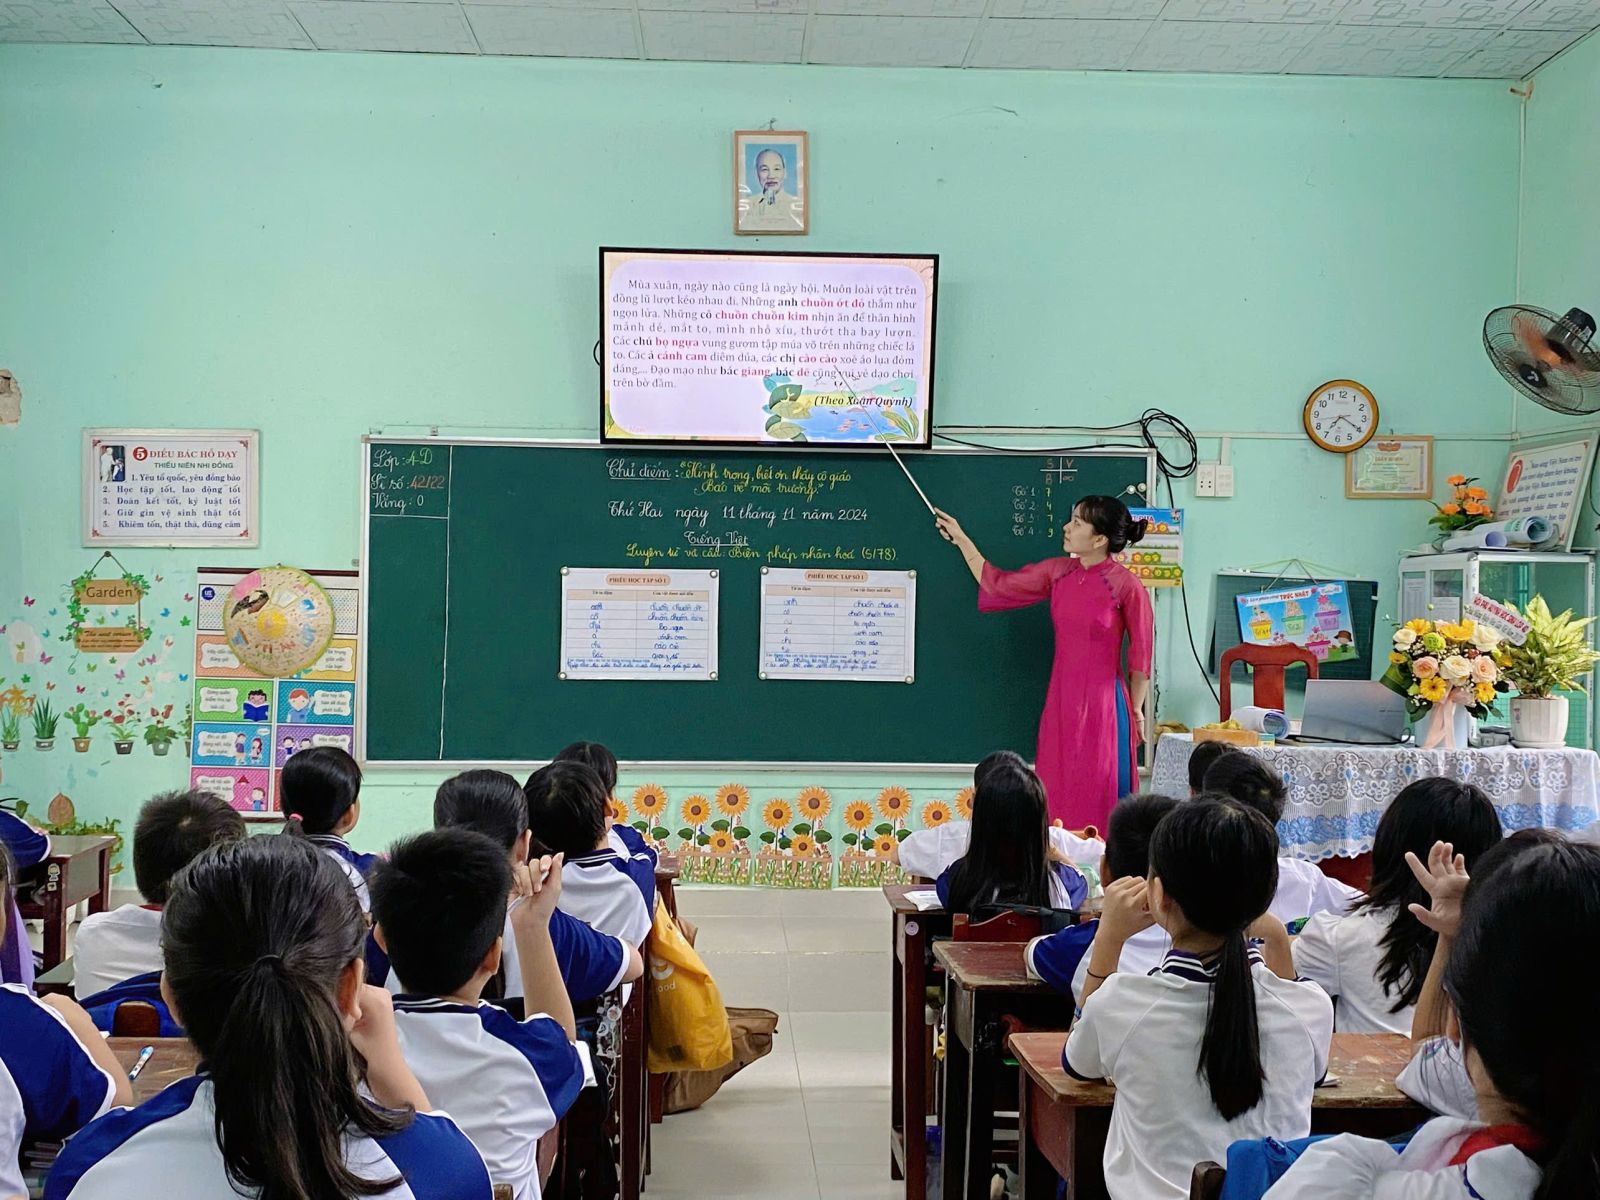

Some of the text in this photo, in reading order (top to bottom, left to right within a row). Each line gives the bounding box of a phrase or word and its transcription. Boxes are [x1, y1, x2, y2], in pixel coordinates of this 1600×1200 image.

[1320, 400, 1328, 408] 10
[1358, 404, 1365, 412] 2
[136, 448, 145, 460] 5
[372, 448, 400, 472] Lớp
[606, 458, 636, 478] Chủ
[416, 494, 424, 506] 0
[608, 500, 868, 528] Thứ Hai ngày 11 tháng 11 năm 2024
[684, 530, 749, 552] Tiếng Việt
[86, 586, 132, 598] Garden
